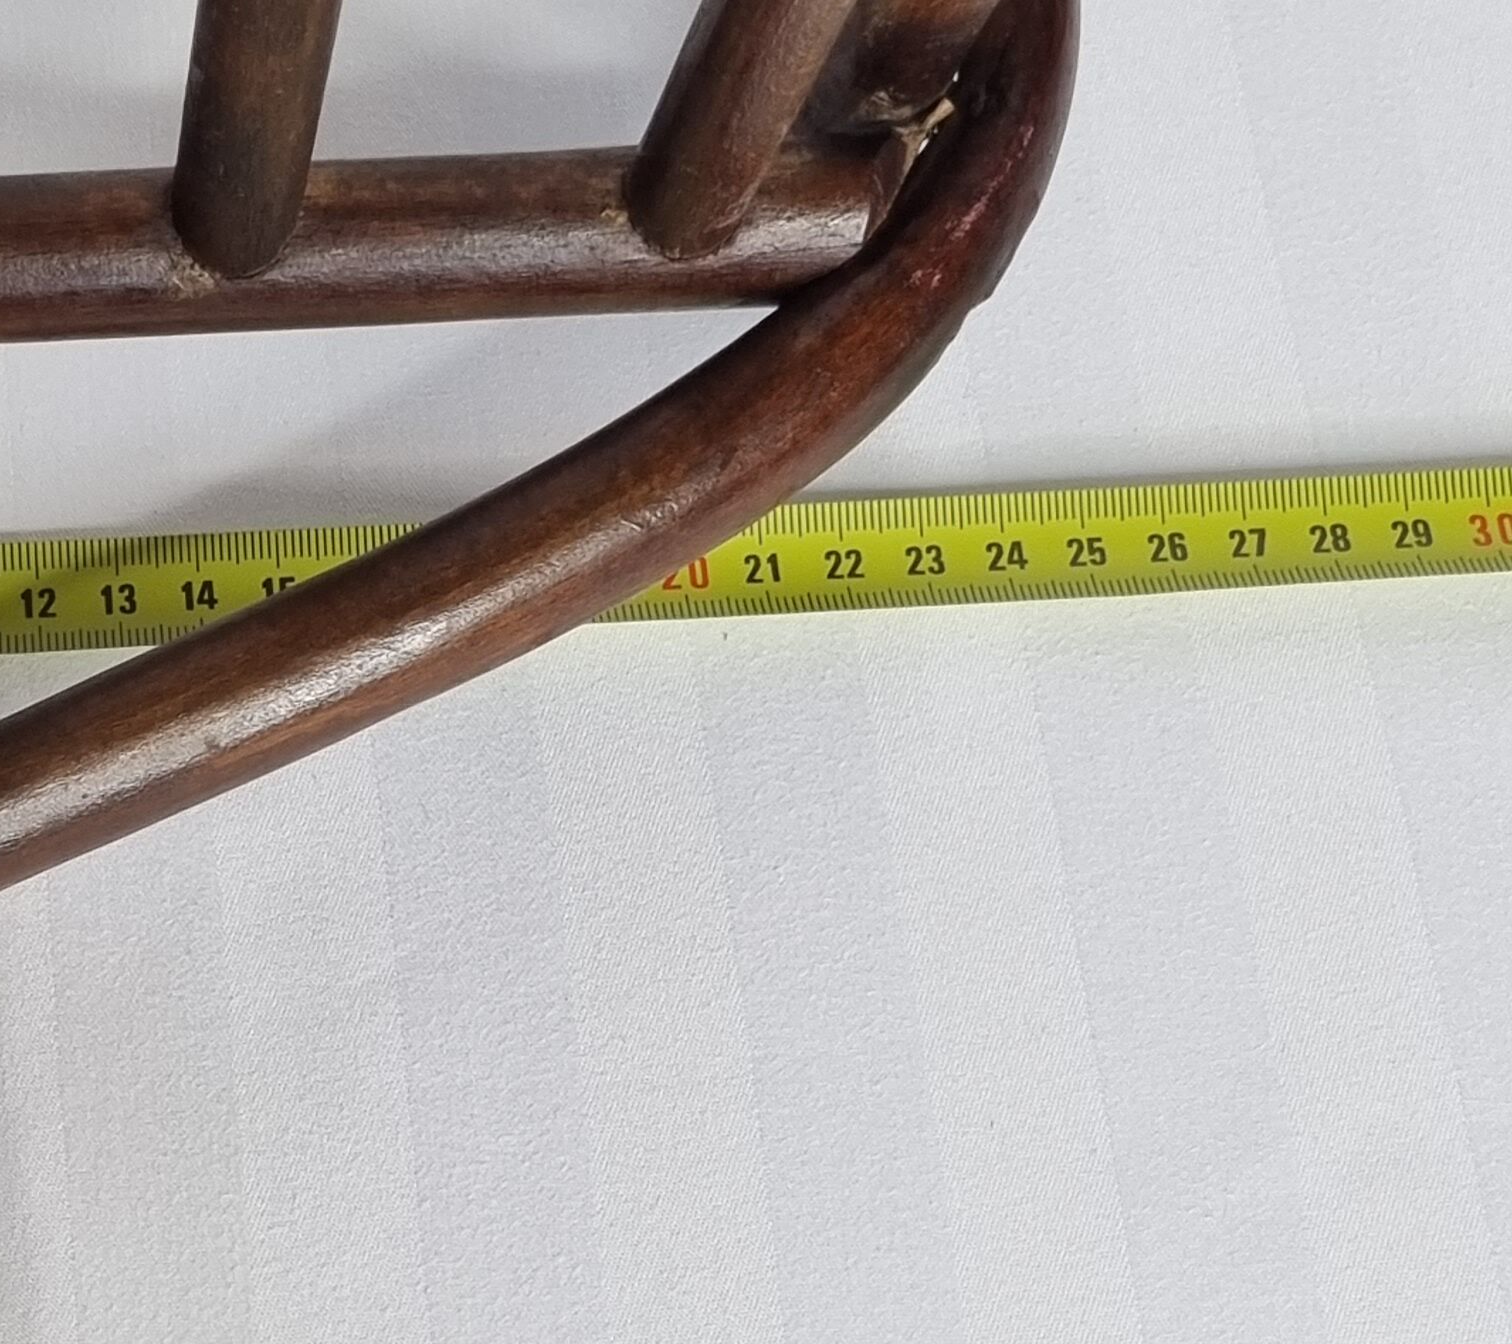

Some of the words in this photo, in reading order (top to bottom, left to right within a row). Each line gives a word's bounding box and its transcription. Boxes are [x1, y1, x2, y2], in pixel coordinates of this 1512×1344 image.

[20, 588, 57, 619] 12
[100, 584, 137, 615] 13
[181, 580, 218, 611] 14
[744, 553, 781, 583] 21
[824, 550, 865, 579] 22
[905, 545, 946, 575] 23
[986, 541, 1028, 571] 24
[1067, 537, 1107, 567] 25
[1147, 532, 1188, 562] 26
[1229, 528, 1267, 557] 27
[1309, 523, 1351, 553] 28
[1391, 519, 1433, 548] 29
[1469, 513, 1512, 546] 30
